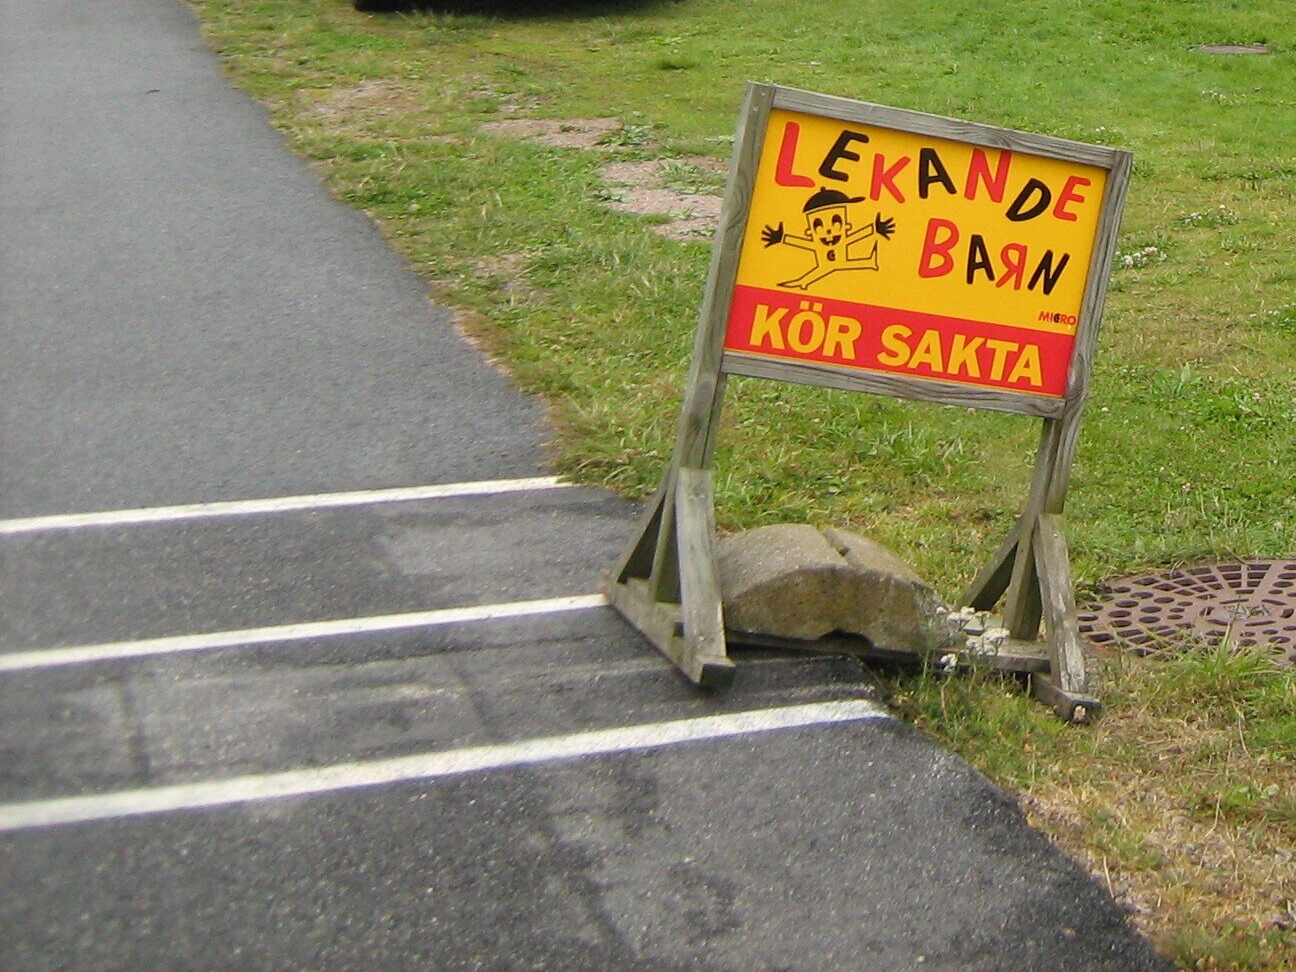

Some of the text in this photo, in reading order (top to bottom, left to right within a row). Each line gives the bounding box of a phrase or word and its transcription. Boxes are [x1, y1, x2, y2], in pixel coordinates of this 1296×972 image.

[775, 122, 1091, 221] LEKANDE
[749, 300, 1043, 387] KÖR SAKTA
[1038, 311, 1077, 325] MICRO
